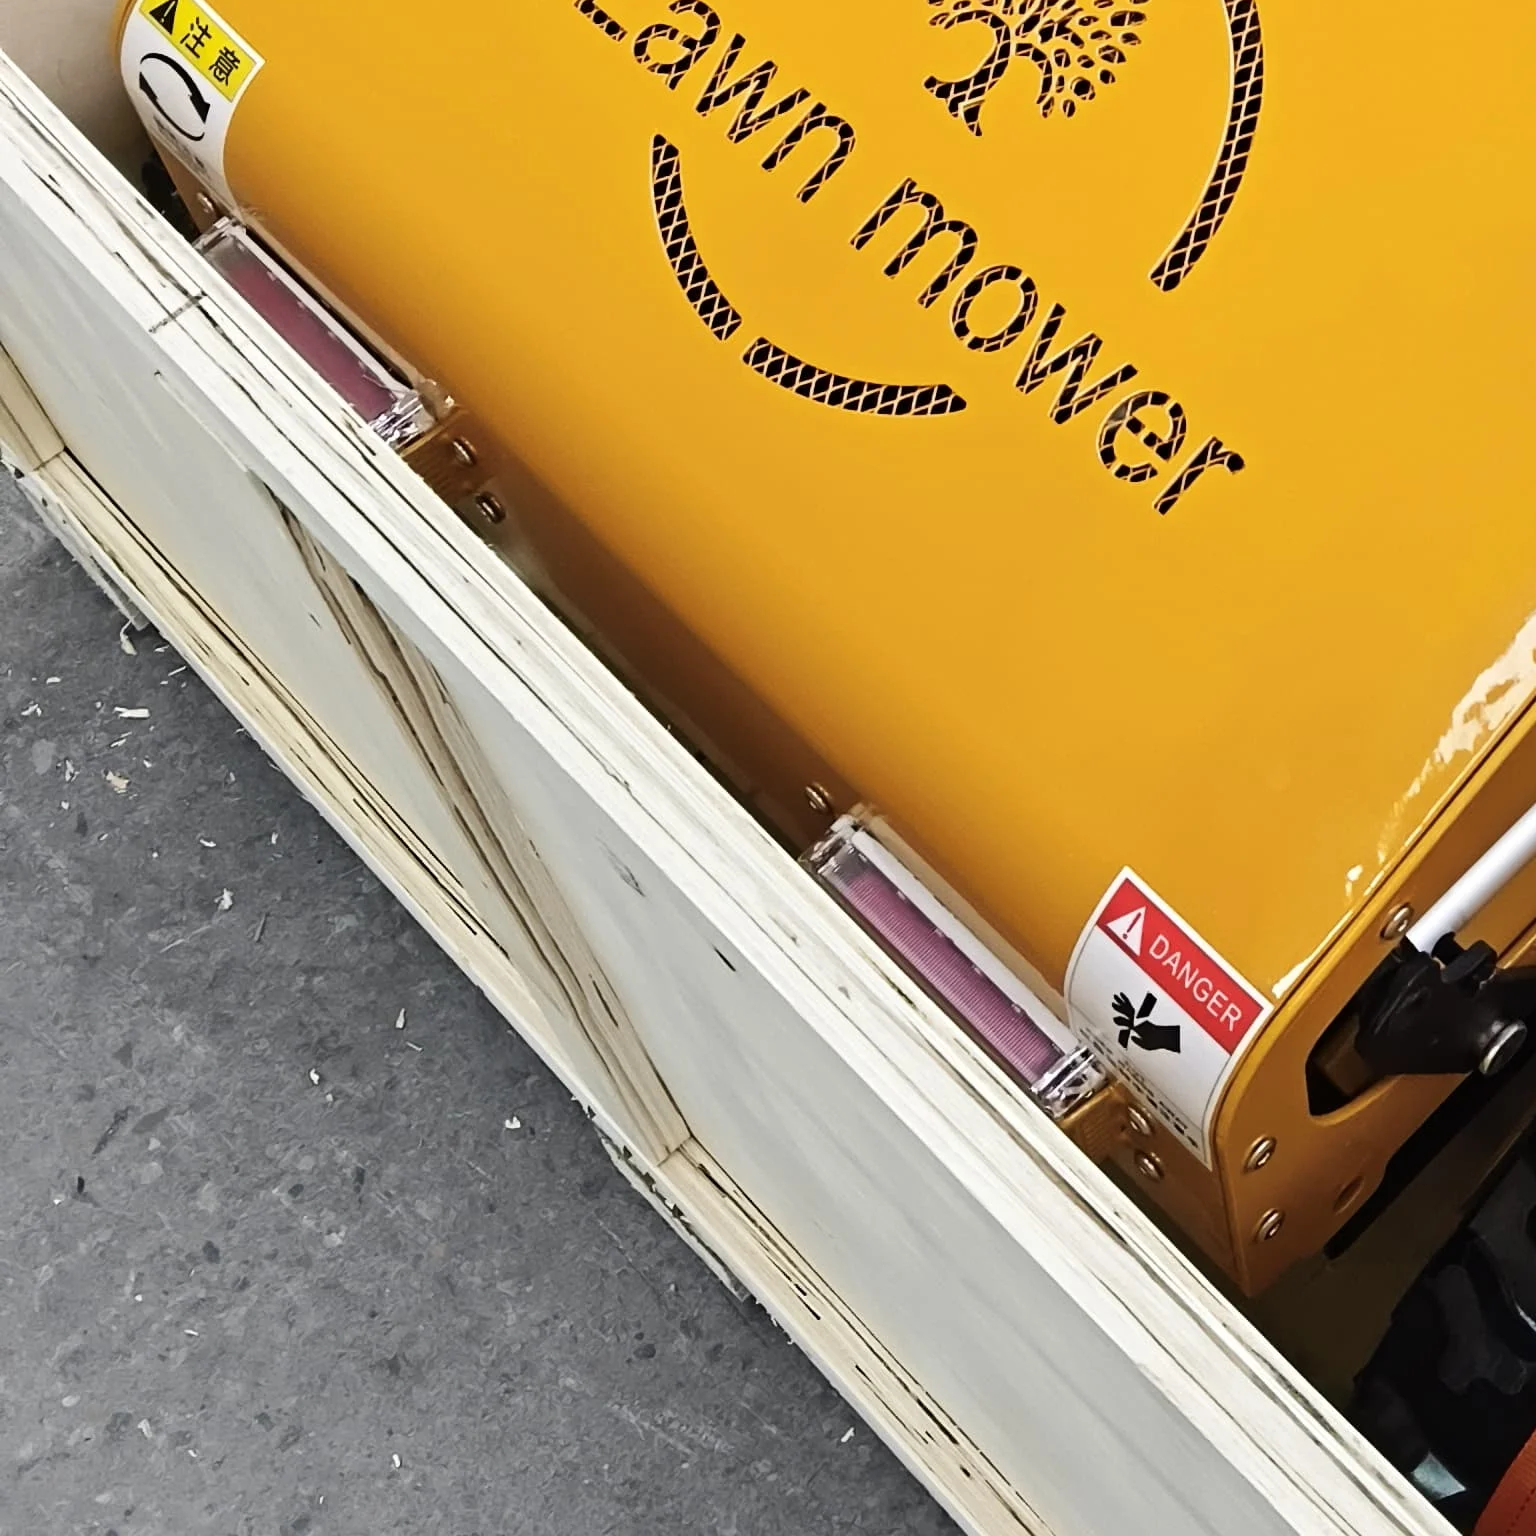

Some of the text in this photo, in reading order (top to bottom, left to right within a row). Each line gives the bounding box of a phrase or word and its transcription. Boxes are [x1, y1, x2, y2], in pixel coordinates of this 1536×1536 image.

[180, 17, 240, 86] 注意
[849, 176, 1246, 516] mower
[1149, 935, 1242, 1031] DANGER
